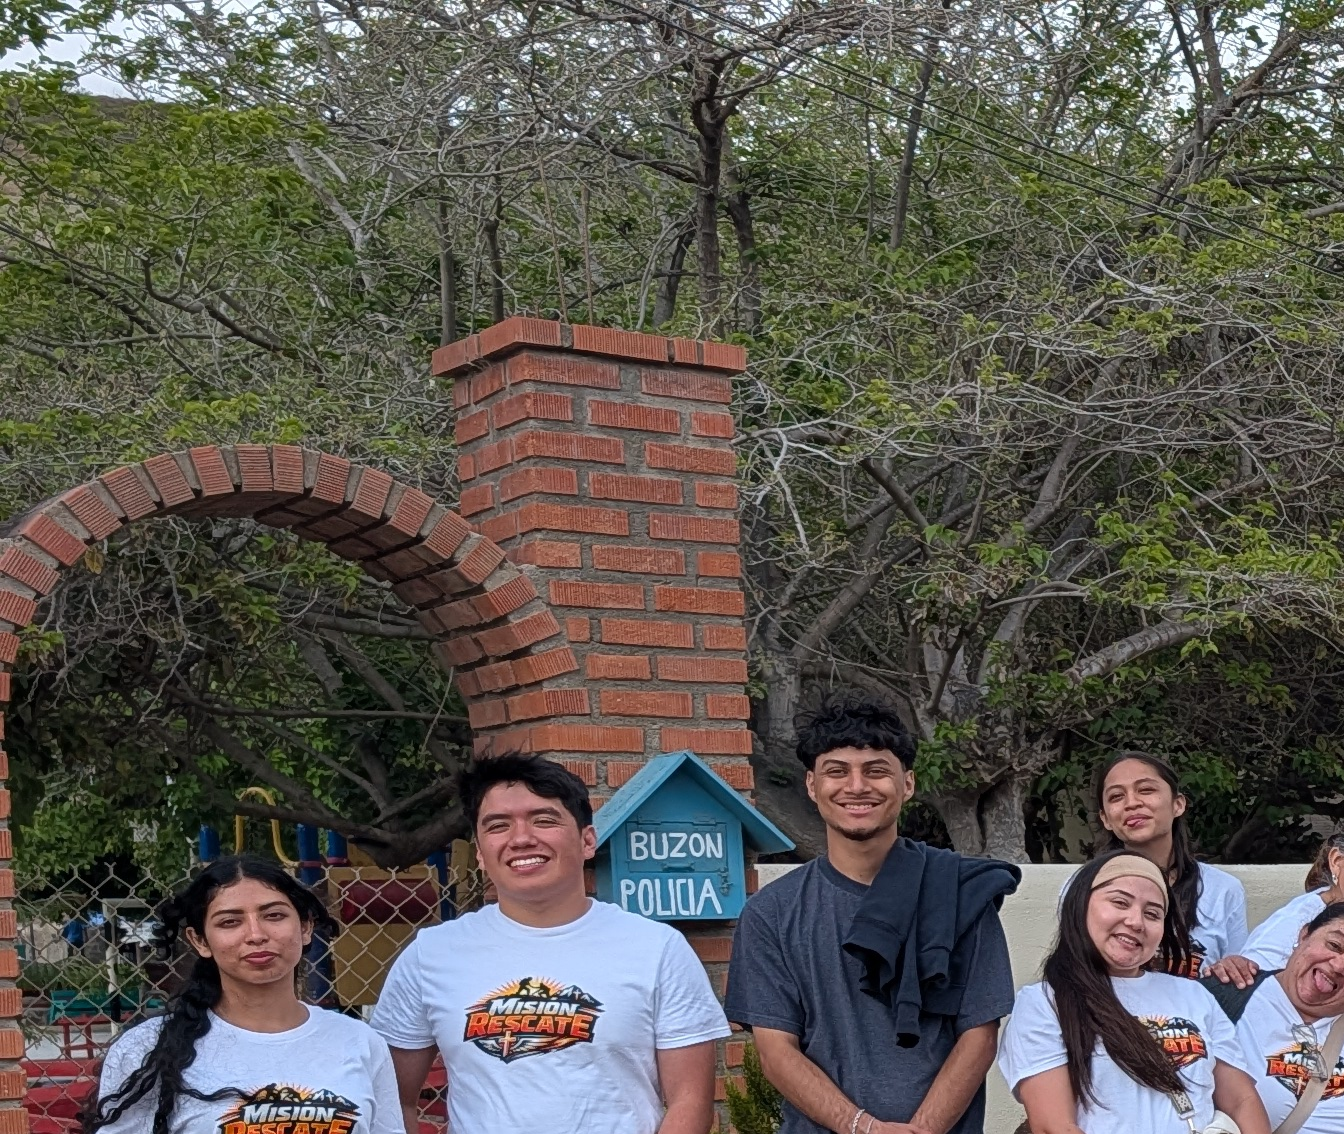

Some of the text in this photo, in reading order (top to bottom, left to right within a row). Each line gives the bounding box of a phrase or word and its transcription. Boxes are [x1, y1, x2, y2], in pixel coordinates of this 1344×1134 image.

[630, 831, 723, 861] BUZON
[620, 878, 723, 916] POLICIA
[466, 1011, 594, 1039] RESCATE
